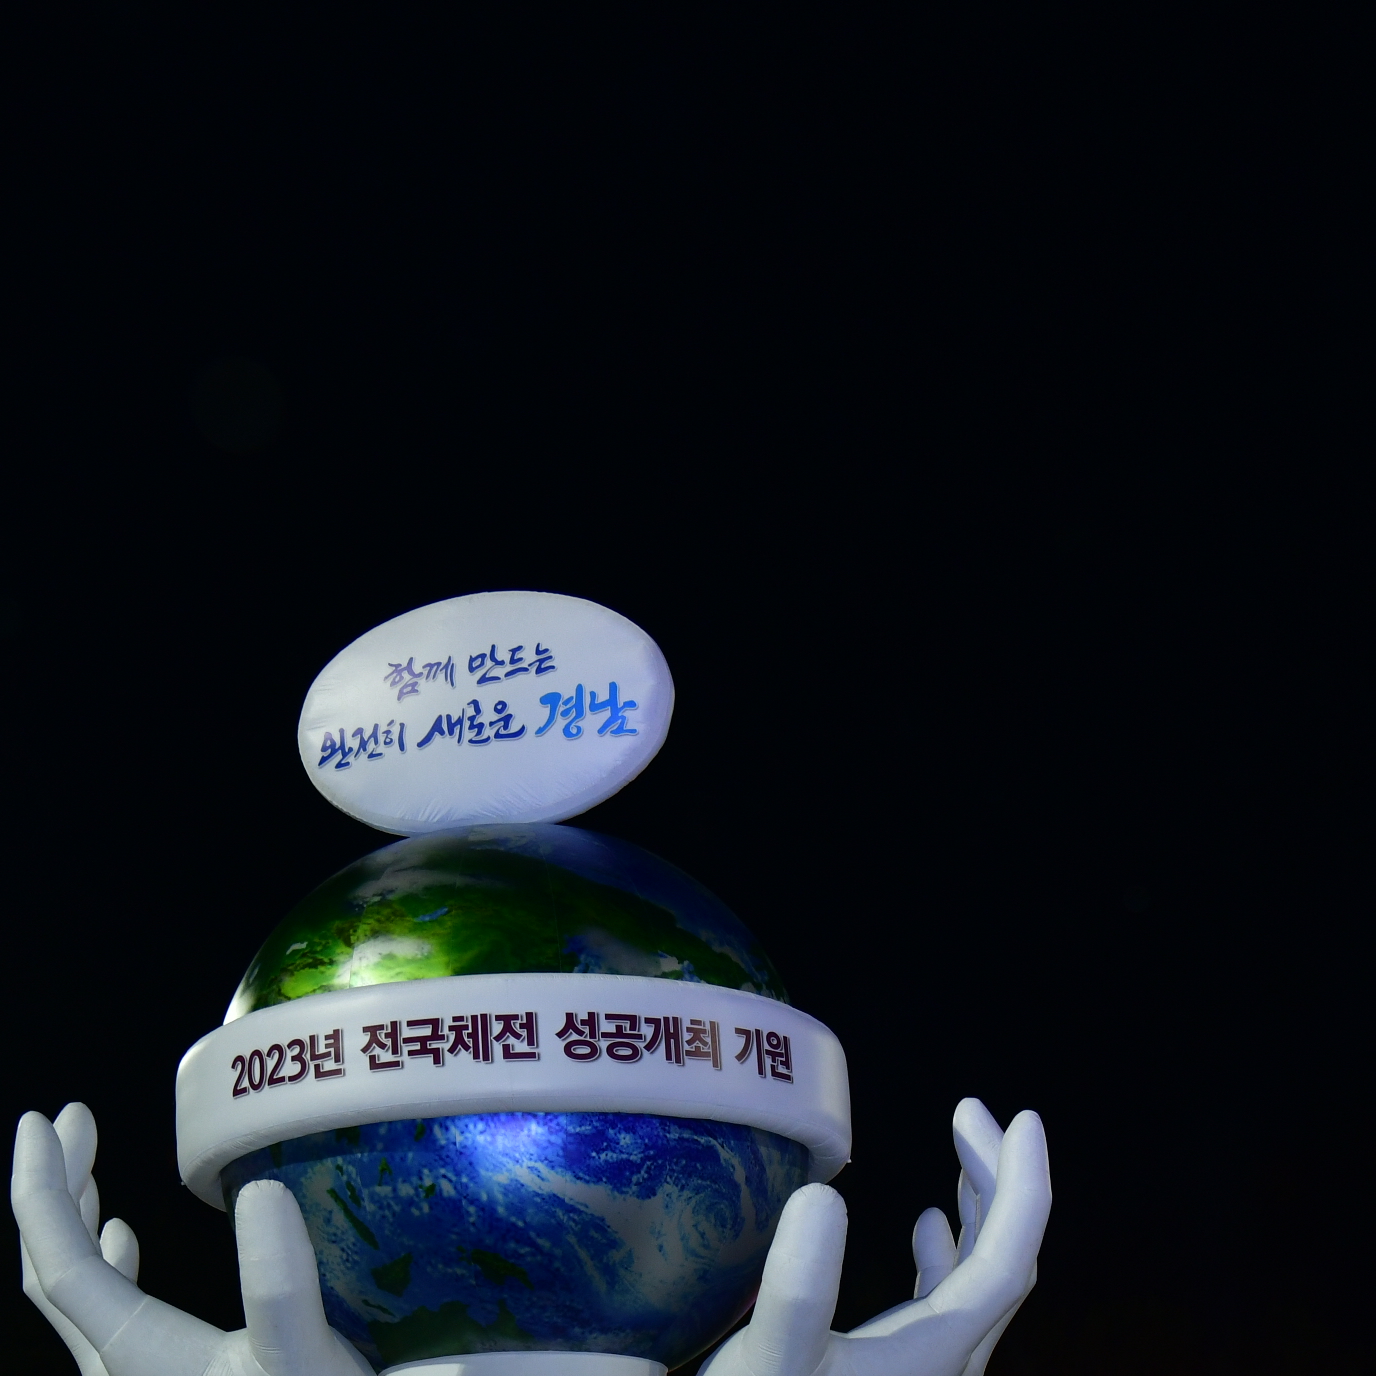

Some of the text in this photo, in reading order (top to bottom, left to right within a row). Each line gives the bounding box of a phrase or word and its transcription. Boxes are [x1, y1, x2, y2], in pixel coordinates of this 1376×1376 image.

[383, 642, 556, 702] 함께 만드는
[318, 680, 639, 770] 완전히 새로운 경남
[231, 1010, 795, 1098] 2023년 전국체전 성공개최 기원
